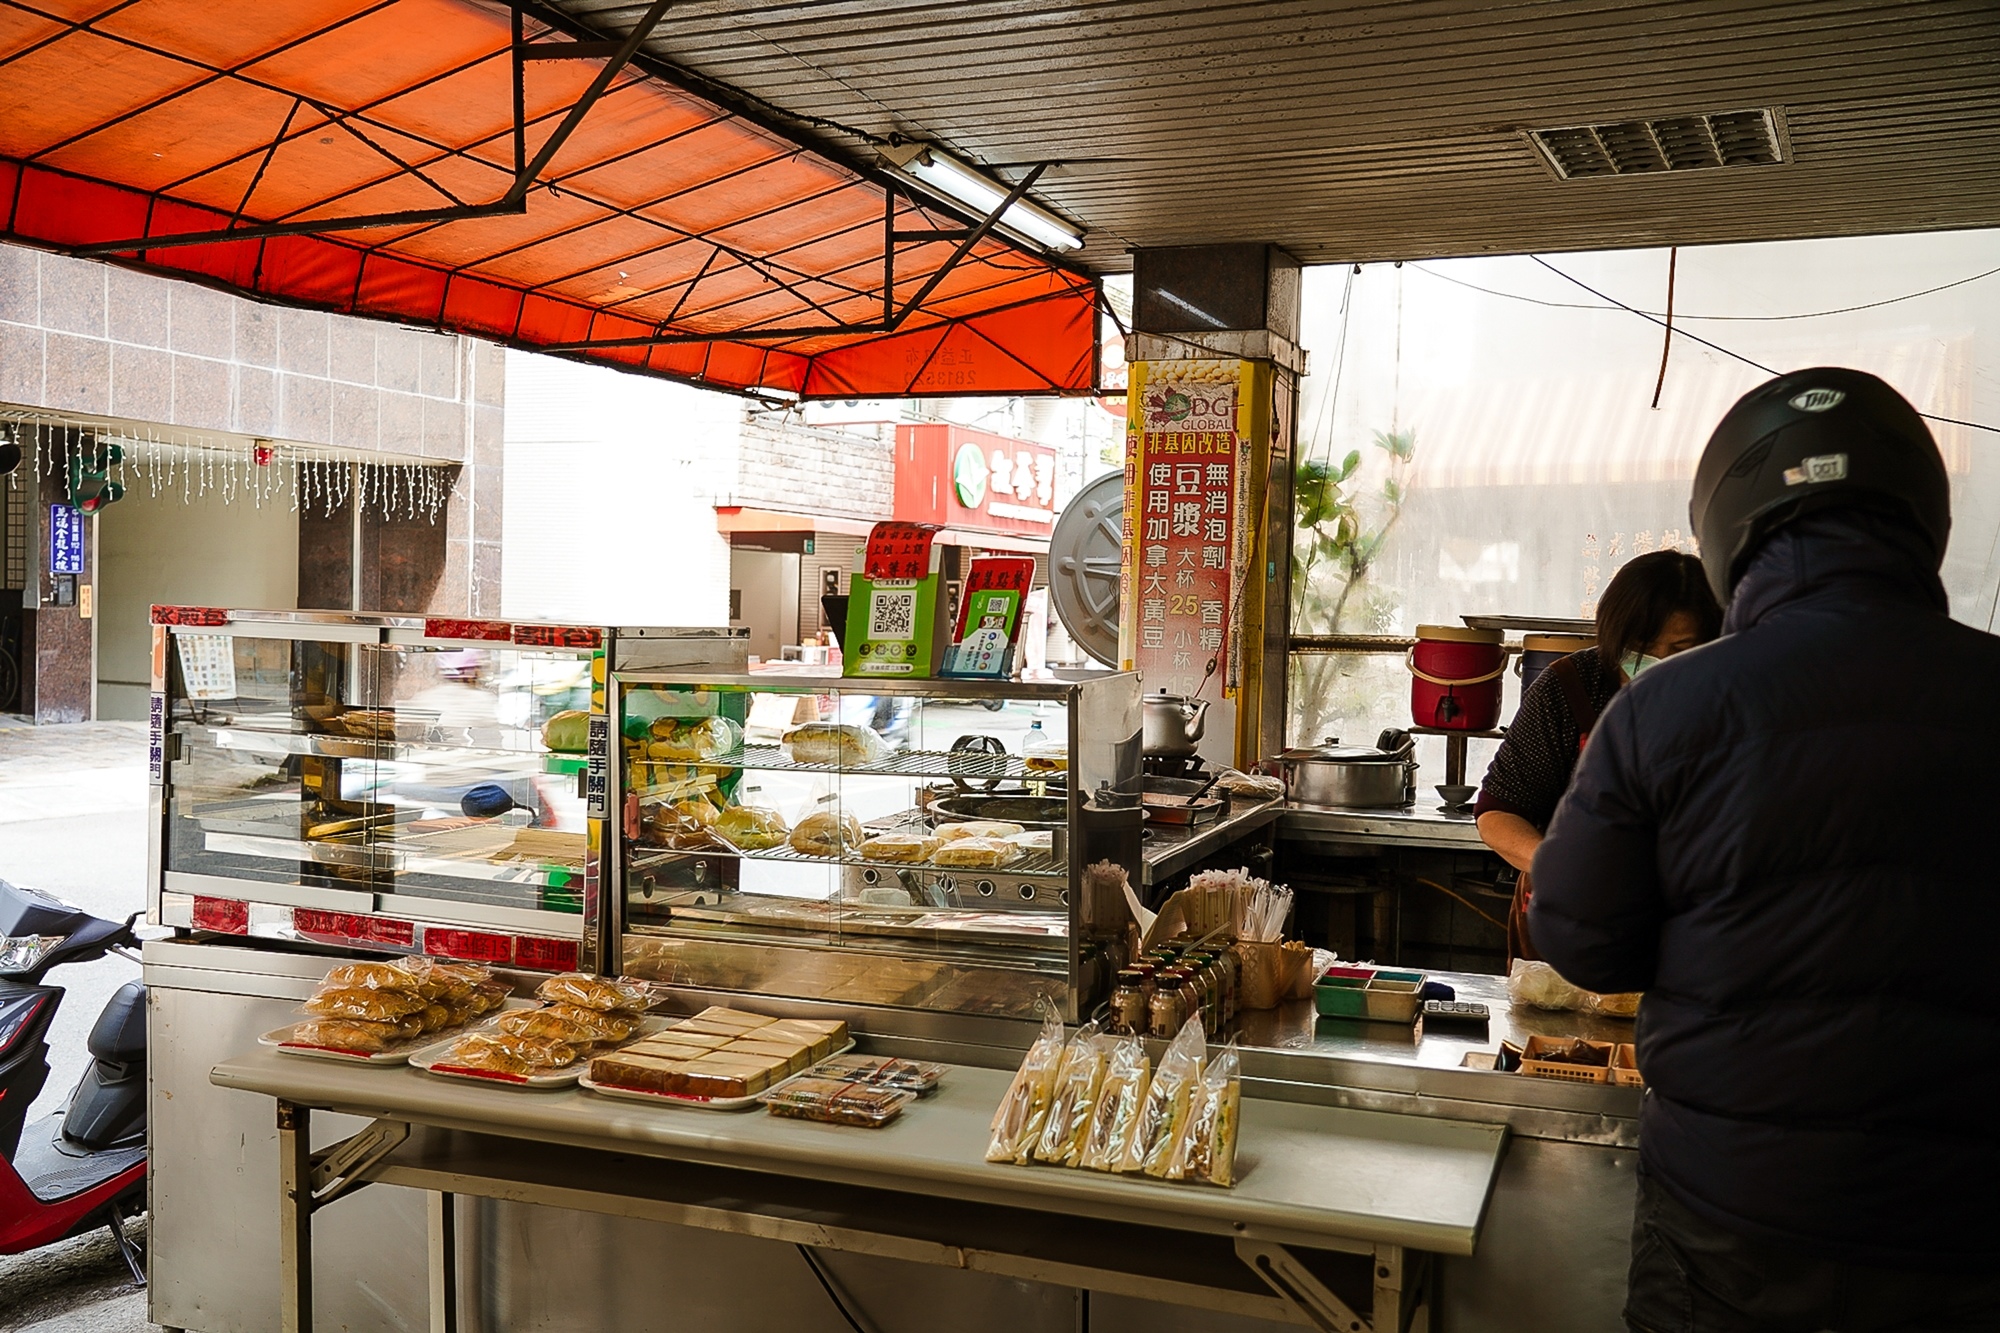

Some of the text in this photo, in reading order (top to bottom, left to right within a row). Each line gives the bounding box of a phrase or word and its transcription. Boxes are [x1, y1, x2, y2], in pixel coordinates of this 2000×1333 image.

[1192, 397, 1230, 417] DG
[1181, 419, 1232, 431] GLOBAL
[1149, 431, 1231, 455] 非基因改造
[1813, 460, 1838, 476] DOT
[1236, 503, 1246, 529] Quality
[1142, 462, 1171, 650] 使用加拿大黃豆
[1235, 530, 1245, 562] Soybeans
[1175, 547, 1196, 589] 大杯
[1169, 594, 1199, 616] 25
[1172, 629, 1192, 671] 小杯
[150, 697, 163, 779] 請隨手關門
[587, 720, 608, 812] 請隨手關門
